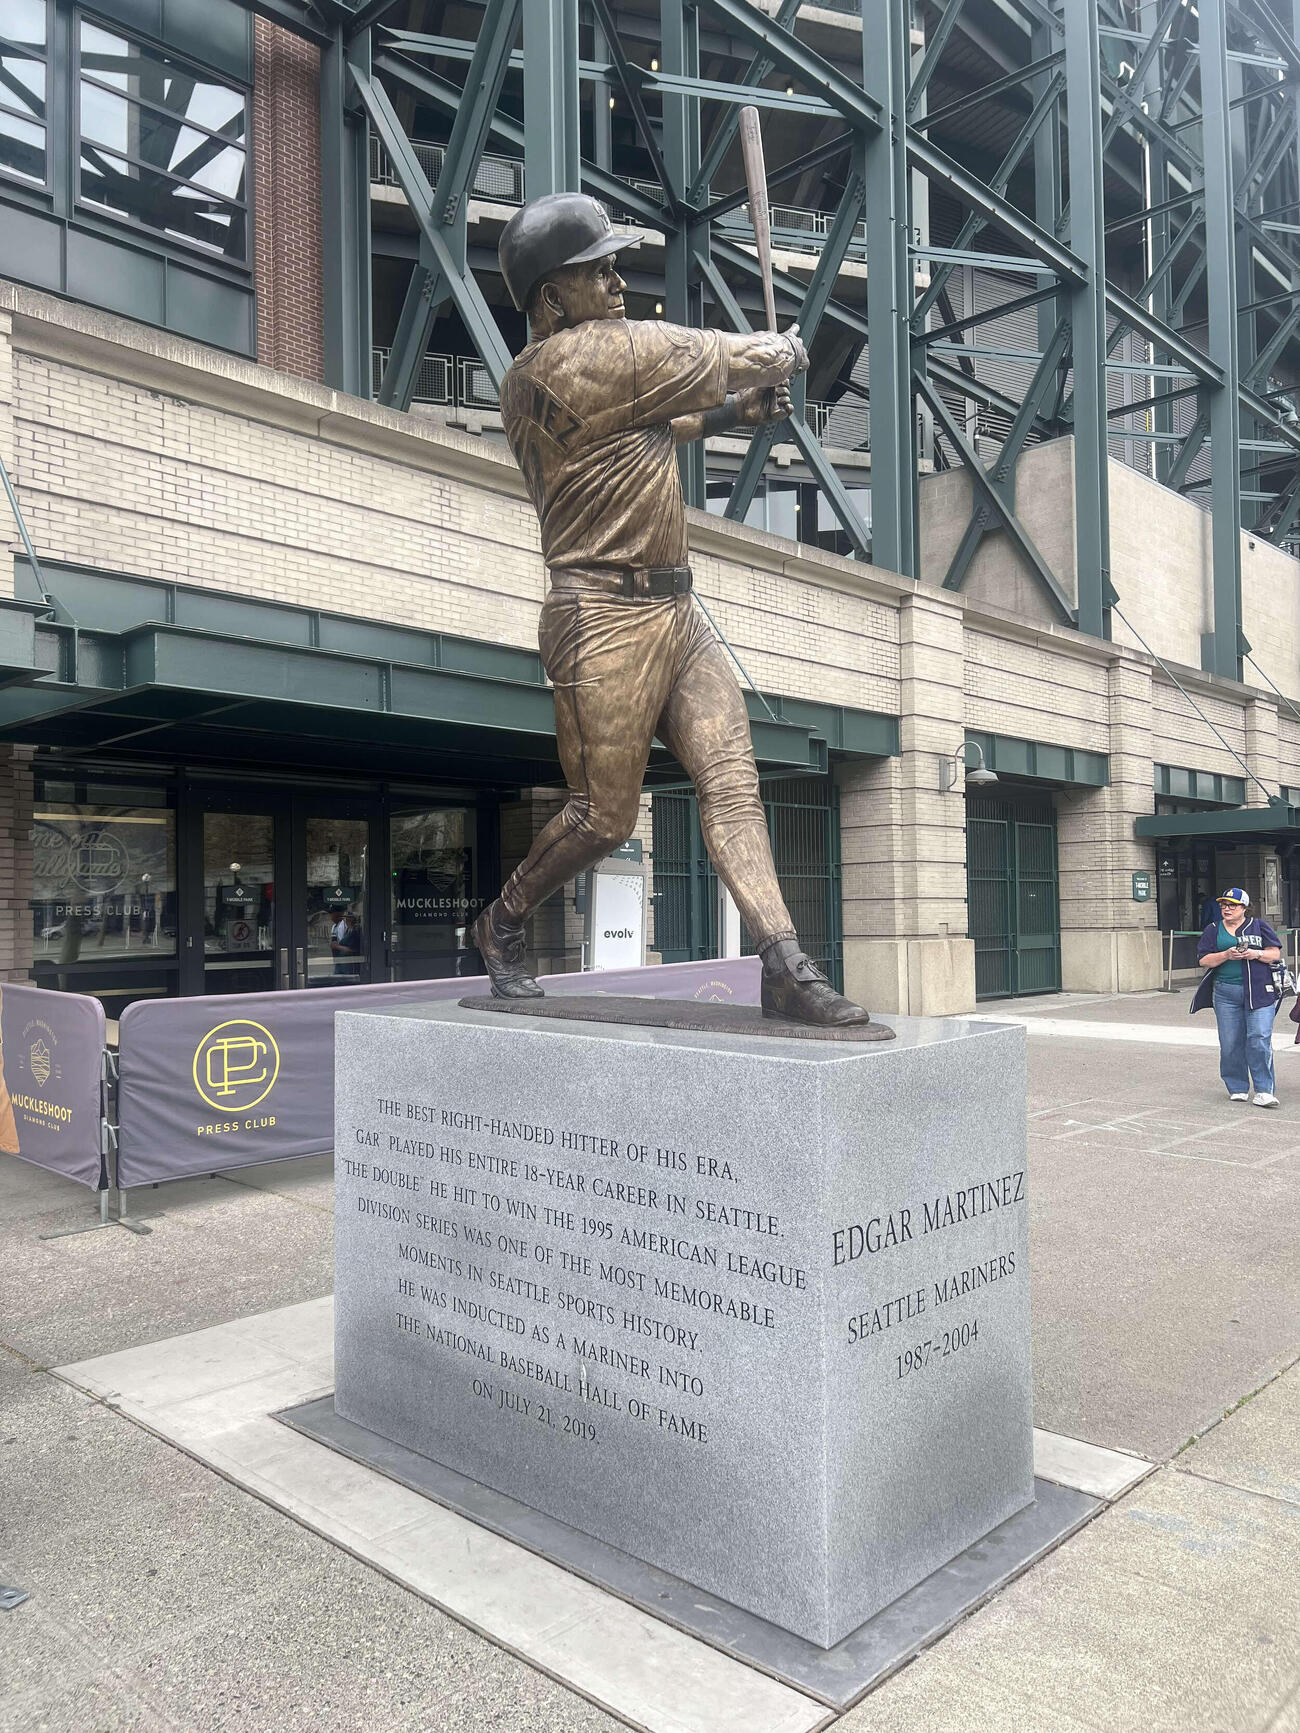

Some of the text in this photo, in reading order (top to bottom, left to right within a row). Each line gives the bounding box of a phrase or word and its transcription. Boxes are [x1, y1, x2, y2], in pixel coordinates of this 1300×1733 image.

[56, 905, 140, 916] PRESS CLUB
[396, 898, 485, 908] MUCKLESHOOT
[603, 928, 634, 938] evolv
[11, 1092, 72, 1123] MUCKLESHOOT
[23, 1114, 60, 1132] DIAMOND CLUB
[198, 1116, 276, 1136] PRESS CLUB
[378, 1099, 738, 1183] THE BEST RIGHT-HANDED HITTER OF HIS ERA,
[390, 1136, 434, 1158] PLAYED
[440, 1146, 462, 1165] HIS
[468, 1152, 518, 1178] ENTIRE
[524, 1164, 585, 1192] 18-YEAR
[592, 1178, 658, 1208] CAREER
[666, 1194, 686, 1215] IN
[696, 1200, 784, 1238] SEATTLE.
[832, 1172, 1024, 1267] EDGAR MARTINEZ
[358, 1197, 775, 1329] DIVISION SERIES WAS ONE OF THE MOST MEMORABLE
[430, 1181, 448, 1198] HE
[454, 1186, 477, 1206] HIT
[482, 1192, 500, 1212] TO
[506, 1198, 537, 1221] WIN
[544, 1208, 575, 1231] THE
[582, 1217, 613, 1240] 1995
[620, 1228, 718, 1266] AMERICAN
[728, 1252, 806, 1290] LEAGUE
[398, 1243, 702, 1352] MOMENTS IN SEATTLE SPORTS HISTORY.
[399, 1278, 704, 1397] HE WAS INDUCTED AS A MARINER INTO
[848, 1252, 1016, 1344] SEATTLE MARINERS
[396, 1312, 708, 1444] THE NATIONAL BASEBALL HALL OF FAME
[896, 1320, 978, 1380] 1987-2004
[472, 1379, 600, 1444] ON JULY 21, 2019.
